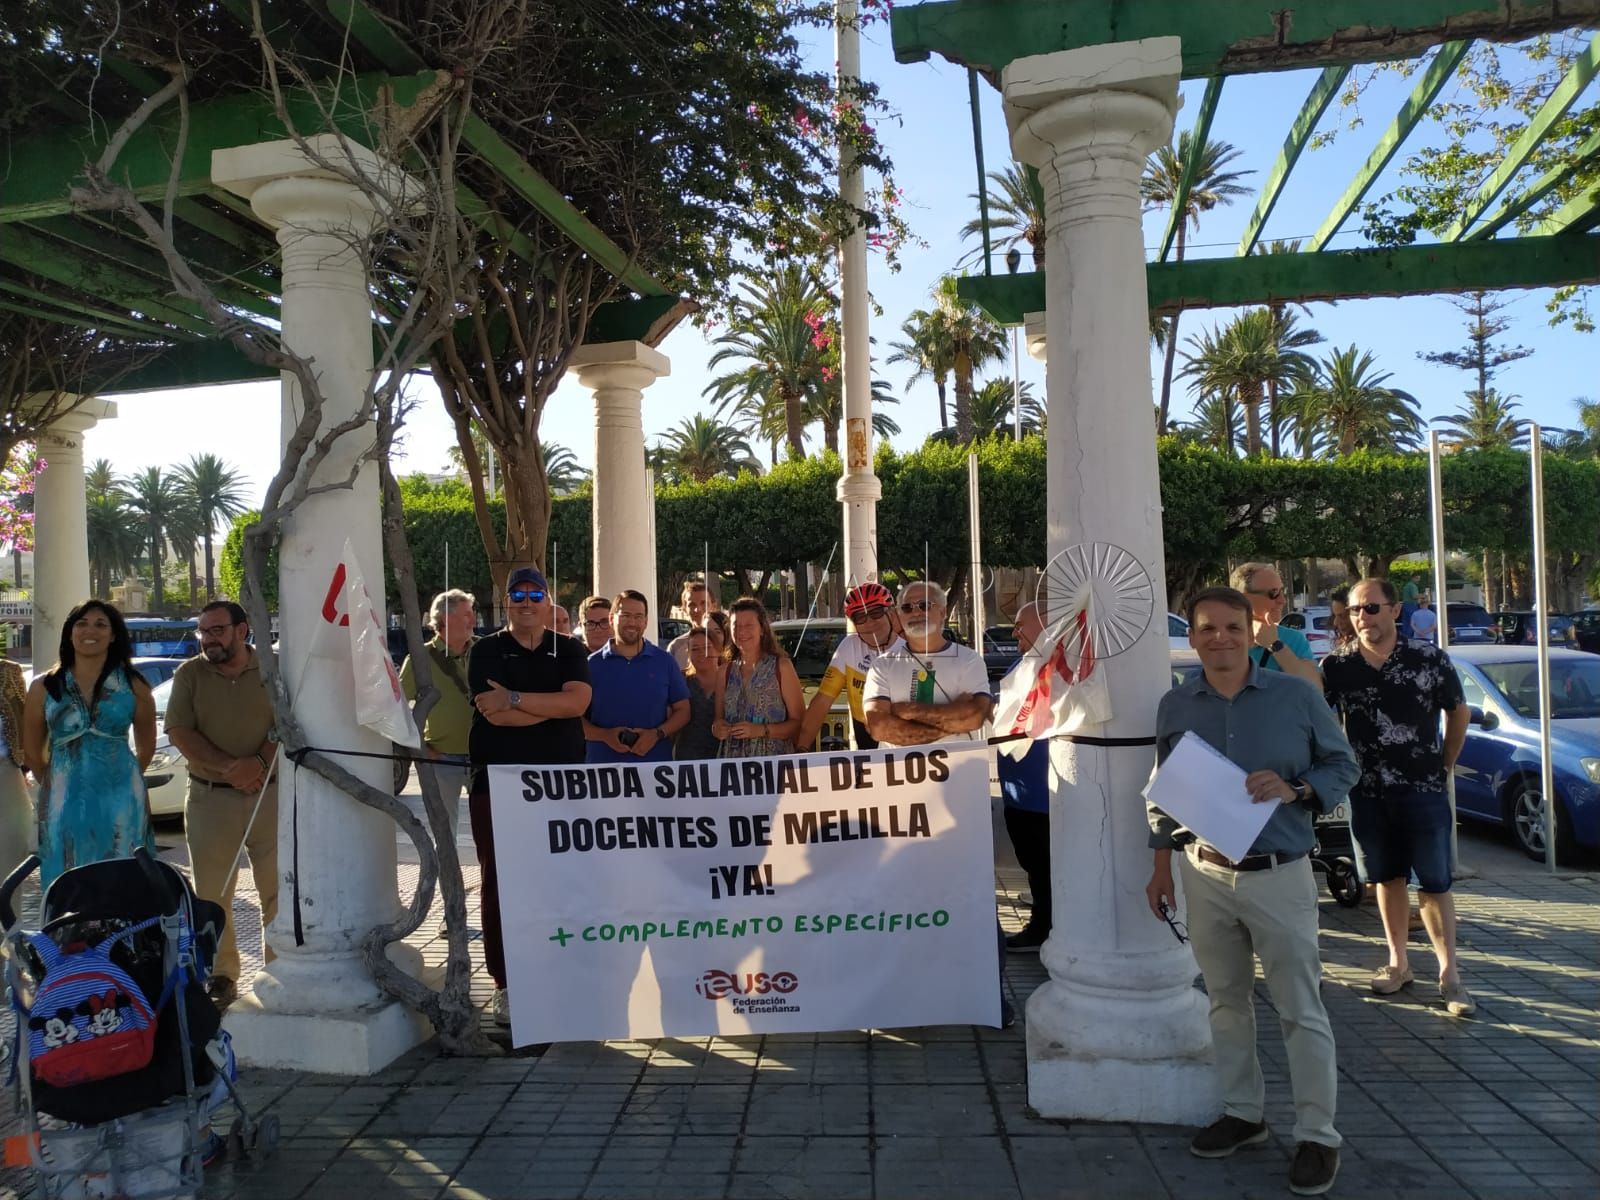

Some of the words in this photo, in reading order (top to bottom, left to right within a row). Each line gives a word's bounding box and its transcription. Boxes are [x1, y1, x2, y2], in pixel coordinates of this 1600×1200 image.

[521, 766, 645, 802] SUBIDA
[653, 759, 818, 798] SALARIAL
[829, 755, 873, 792] DE
[885, 749, 950, 787] LOS
[548, 816, 718, 853] DOCENTES
[729, 814, 772, 848] DE
[783, 803, 931, 845] MELILLA
[709, 864, 775, 899] ¡YA!
[582, 915, 784, 943] COMPLEMENTO
[795, 909, 950, 934] ESPECÍFICO
[732, 996, 786, 1006] Federación
[733, 1006, 745, 1014] de
[748, 1005, 801, 1014] Enseñanza
